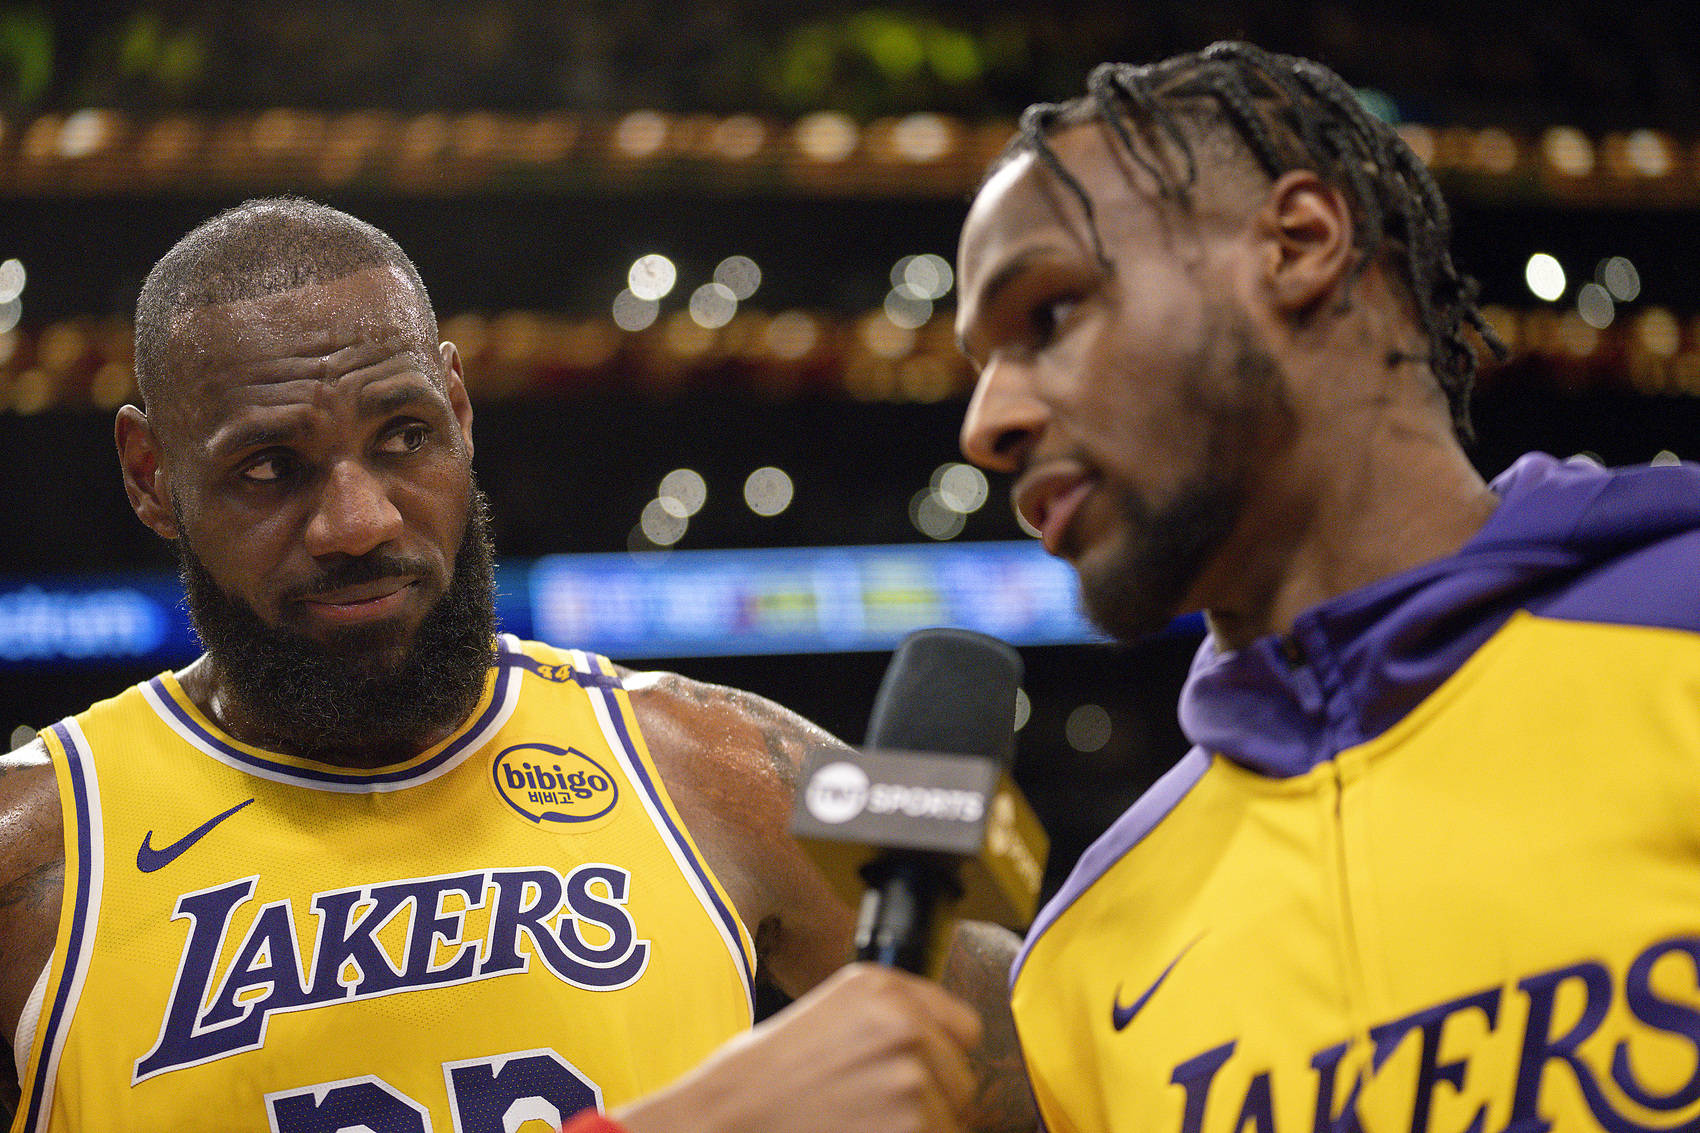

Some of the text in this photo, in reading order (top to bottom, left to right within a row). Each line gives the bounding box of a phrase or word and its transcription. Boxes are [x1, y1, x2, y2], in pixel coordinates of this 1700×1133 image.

[537, 664, 571, 681] 44
[502, 762, 609, 799] bibigo
[528, 791, 575, 805] 비비고
[867, 783, 985, 822] SPORTS
[132, 863, 650, 1088] LAKERS
[1169, 930, 1700, 1133] KERS
